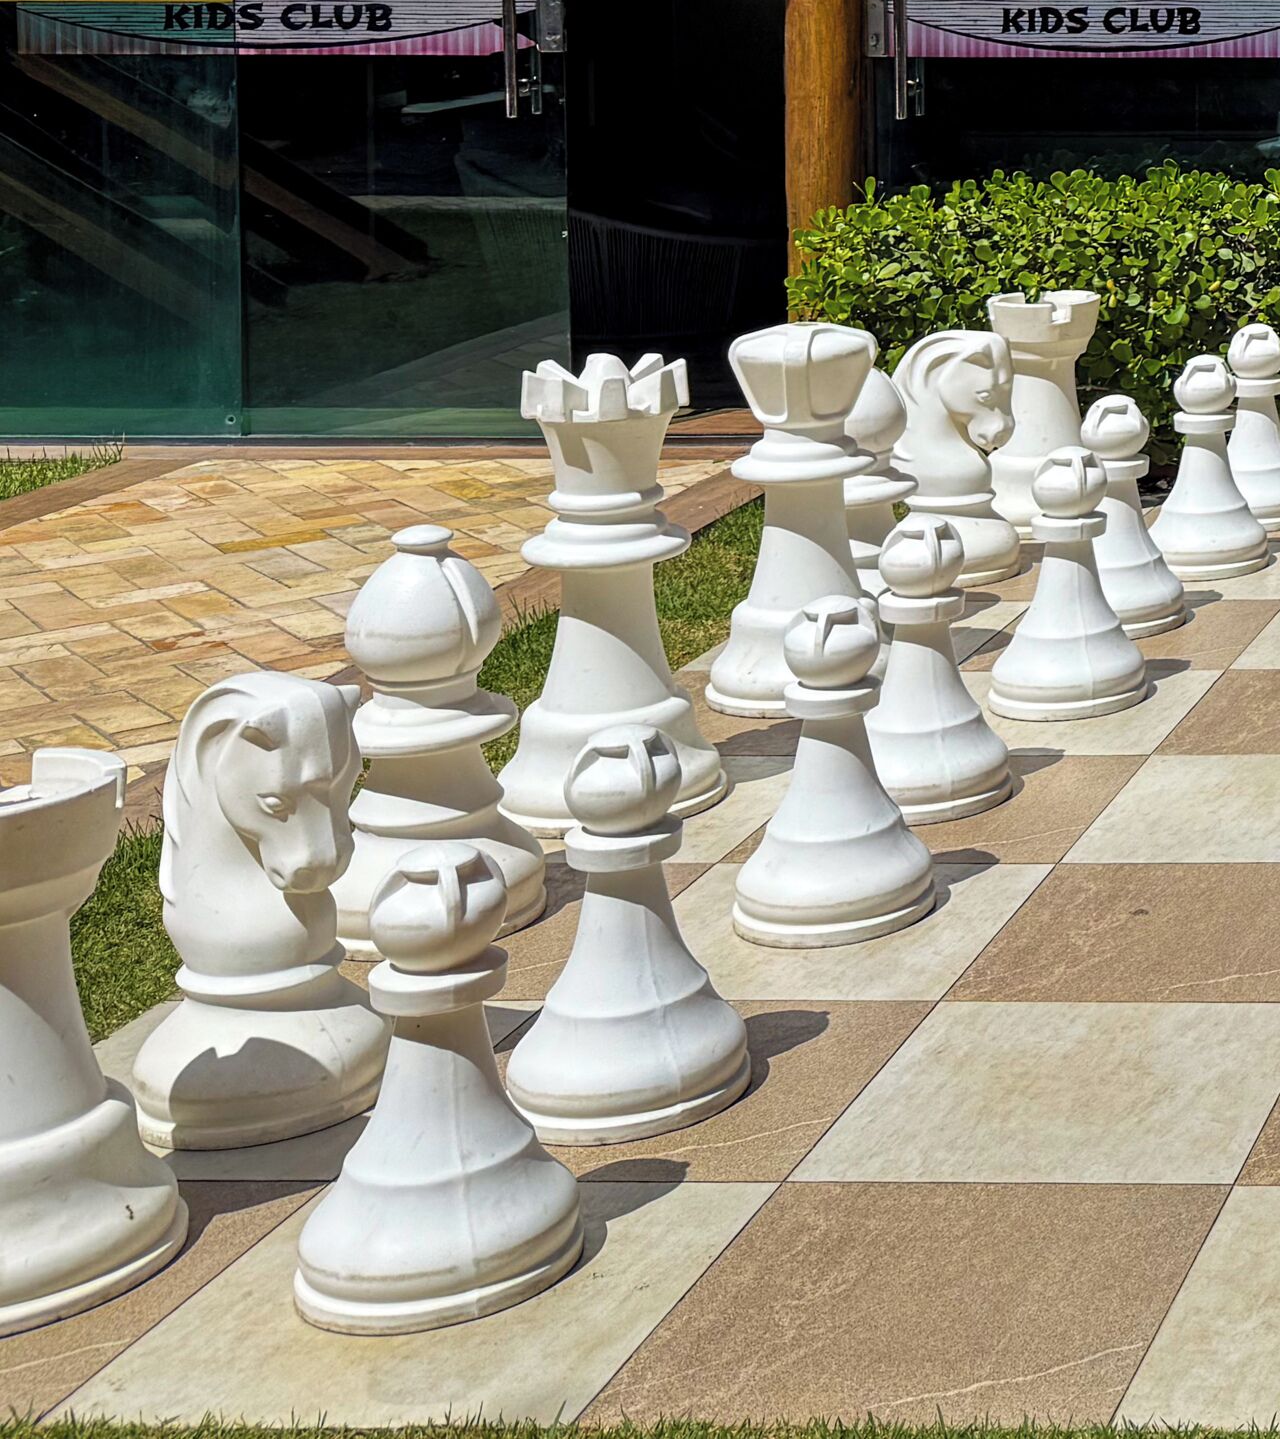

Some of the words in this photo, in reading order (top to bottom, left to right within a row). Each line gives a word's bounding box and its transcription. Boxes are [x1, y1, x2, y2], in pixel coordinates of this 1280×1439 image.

[163, 2, 264, 31] KIDS
[280, 3, 393, 32] CLUB
[1001, 7, 1089, 34] KIDS
[1103, 7, 1201, 35] CLUB
